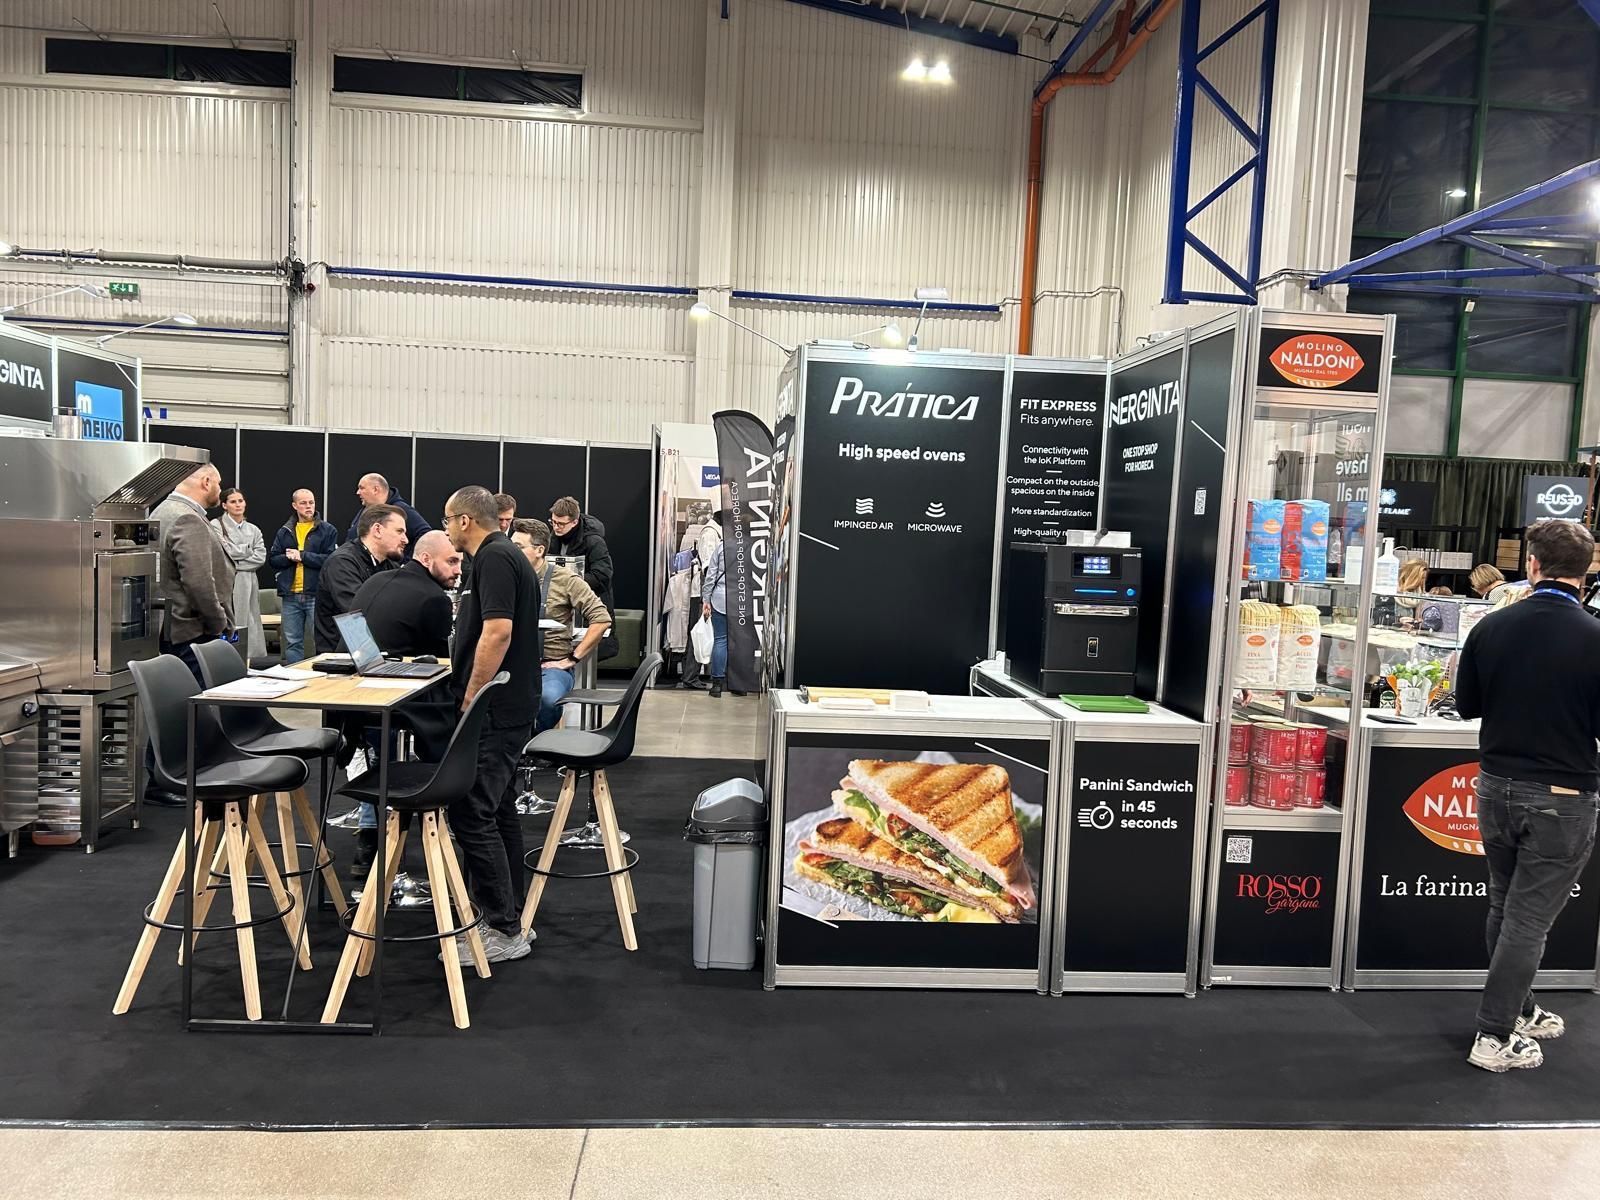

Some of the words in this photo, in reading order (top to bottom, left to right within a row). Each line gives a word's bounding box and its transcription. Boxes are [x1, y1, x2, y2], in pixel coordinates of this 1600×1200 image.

[1296, 342, 1343, 352] MOLINO
[1020, 398, 1040, 410] FIT
[1041, 399, 1097, 412] EXPRESS
[1020, 413, 1040, 424] Fits
[1041, 416, 1094, 427] anywhere.
[838, 443, 873, 460] High
[876, 446, 920, 462] speed
[923, 451, 966, 462] ovens
[1022, 444, 1071, 456] Connectivity
[1072, 447, 1089, 455] with
[1133, 445, 1145, 457] STOP
[1145, 443, 1159, 456] SHOP
[1024, 456, 1037, 464] the
[1052, 457, 1086, 466] Platform
[1134, 460, 1155, 472] HORECA
[1006, 475, 1042, 486] Compact
[1011, 487, 1045, 495] spacious
[1057, 488, 1071, 496] the
[1011, 507, 1032, 515] More
[1033, 508, 1092, 517] standardization
[834, 520, 878, 530] IMPINGED
[878, 521, 893, 530] AIR
[907, 523, 962, 533] MICROWAVE
[1013, 528, 1061, 538] High-quality
[1080, 778, 1123, 791] Panini
[1126, 779, 1194, 792] Sandwich
[1121, 800, 1134, 812] in
[1137, 800, 1156, 813] 45
[1120, 817, 1178, 829] seconds
[1236, 874, 1321, 899] ROSSO
[1380, 875, 1408, 896] La
[1414, 874, 1487, 897] farina
[1265, 890, 1320, 915] Gargano
